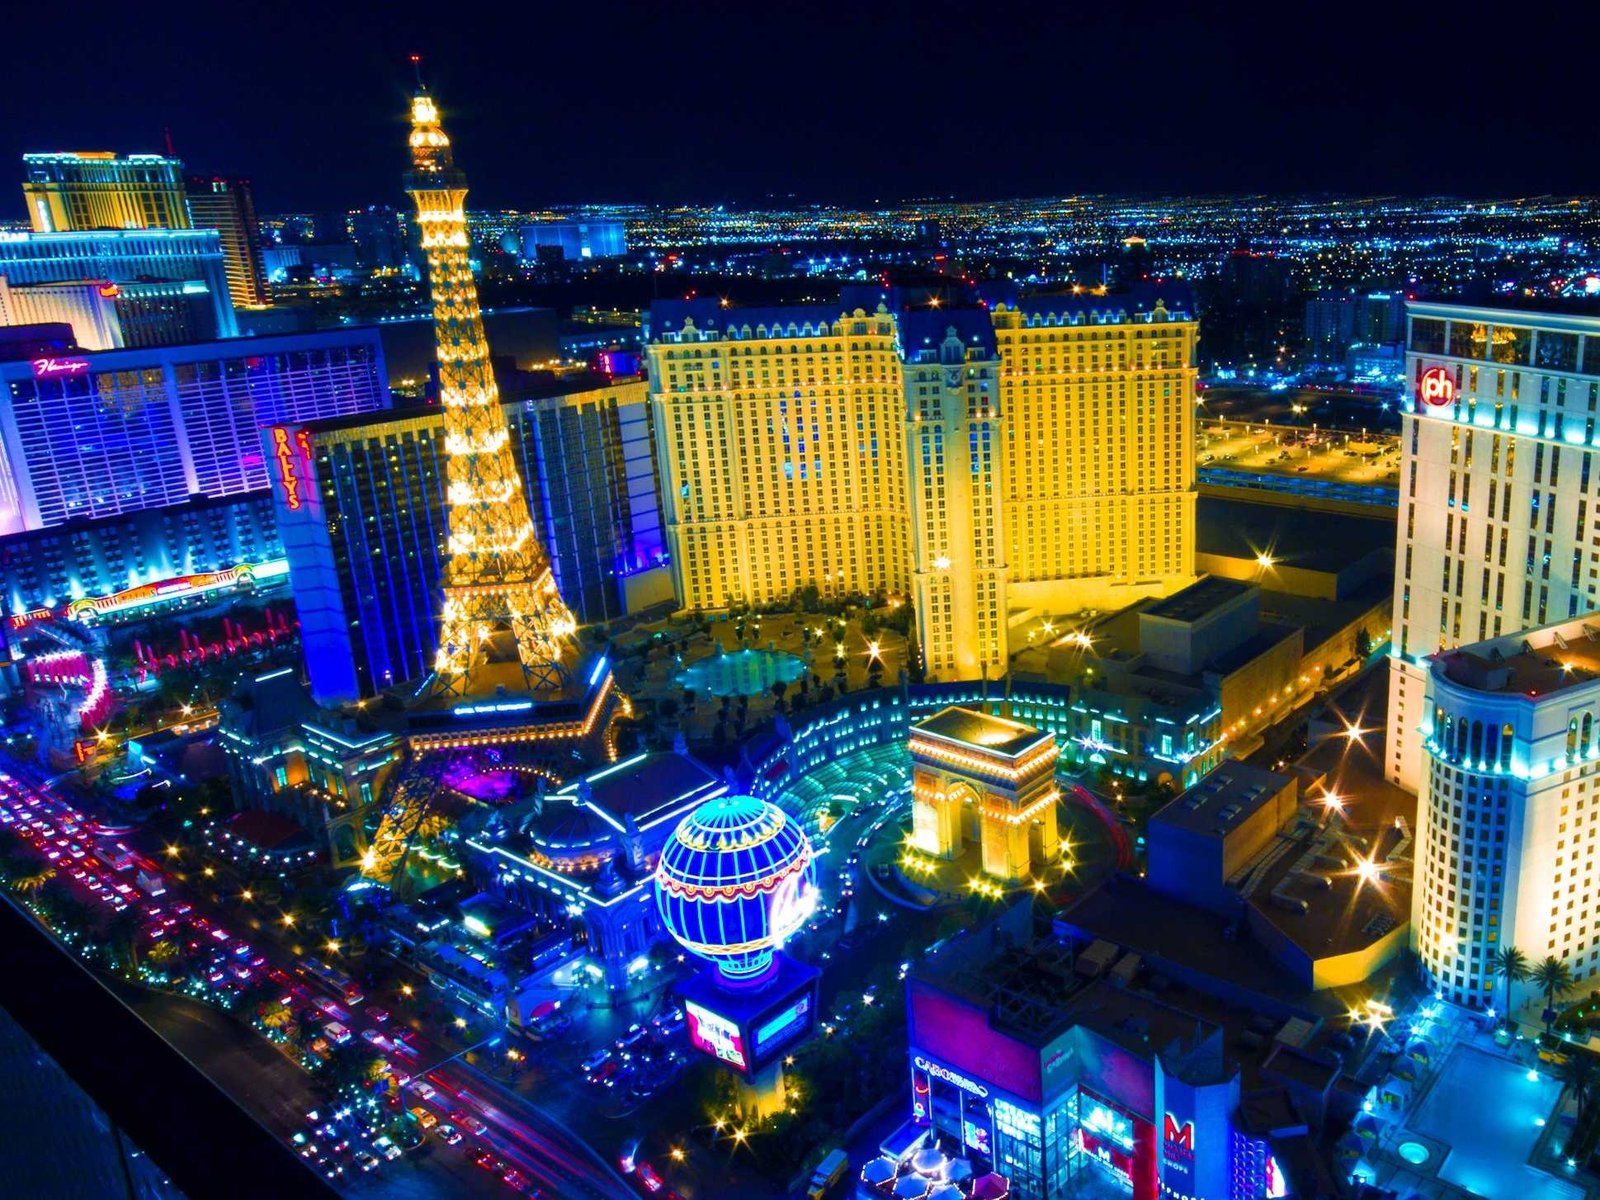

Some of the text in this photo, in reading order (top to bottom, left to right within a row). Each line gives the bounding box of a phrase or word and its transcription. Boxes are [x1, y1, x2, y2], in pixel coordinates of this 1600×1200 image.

[33, 358, 88, 375] Flamingo
[1425, 369, 1453, 402] ph
[1164, 1111, 1195, 1151] M
